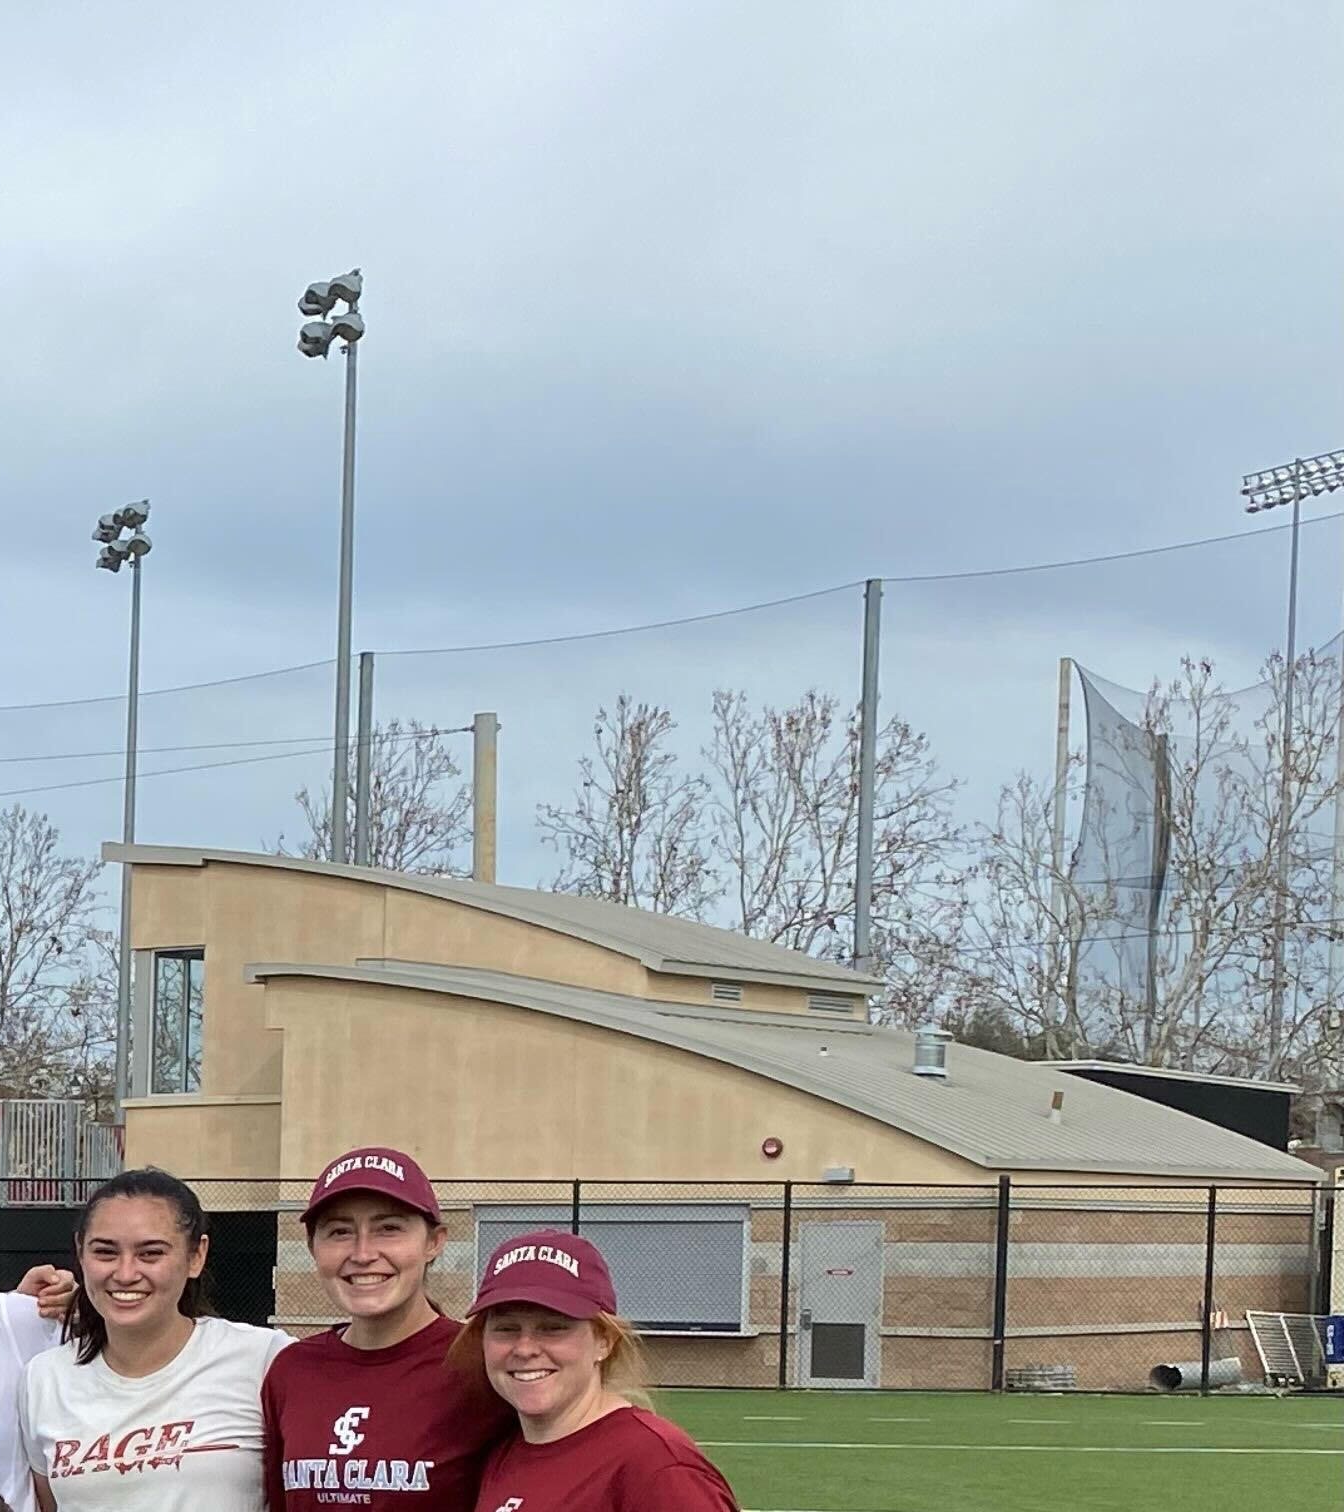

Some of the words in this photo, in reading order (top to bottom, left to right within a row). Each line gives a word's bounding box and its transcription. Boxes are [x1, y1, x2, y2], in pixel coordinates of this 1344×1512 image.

[324, 1157, 363, 1188] SANTA
[364, 1155, 405, 1181] CLARA
[493, 1245, 536, 1276] SANTA
[537, 1245, 579, 1278] CLARA
[51, 1420, 195, 1478] RAGE
[282, 1459, 340, 1491] ANTA
[344, 1459, 431, 1491] CLARA
[317, 1493, 372, 1504] ULTIMATE
